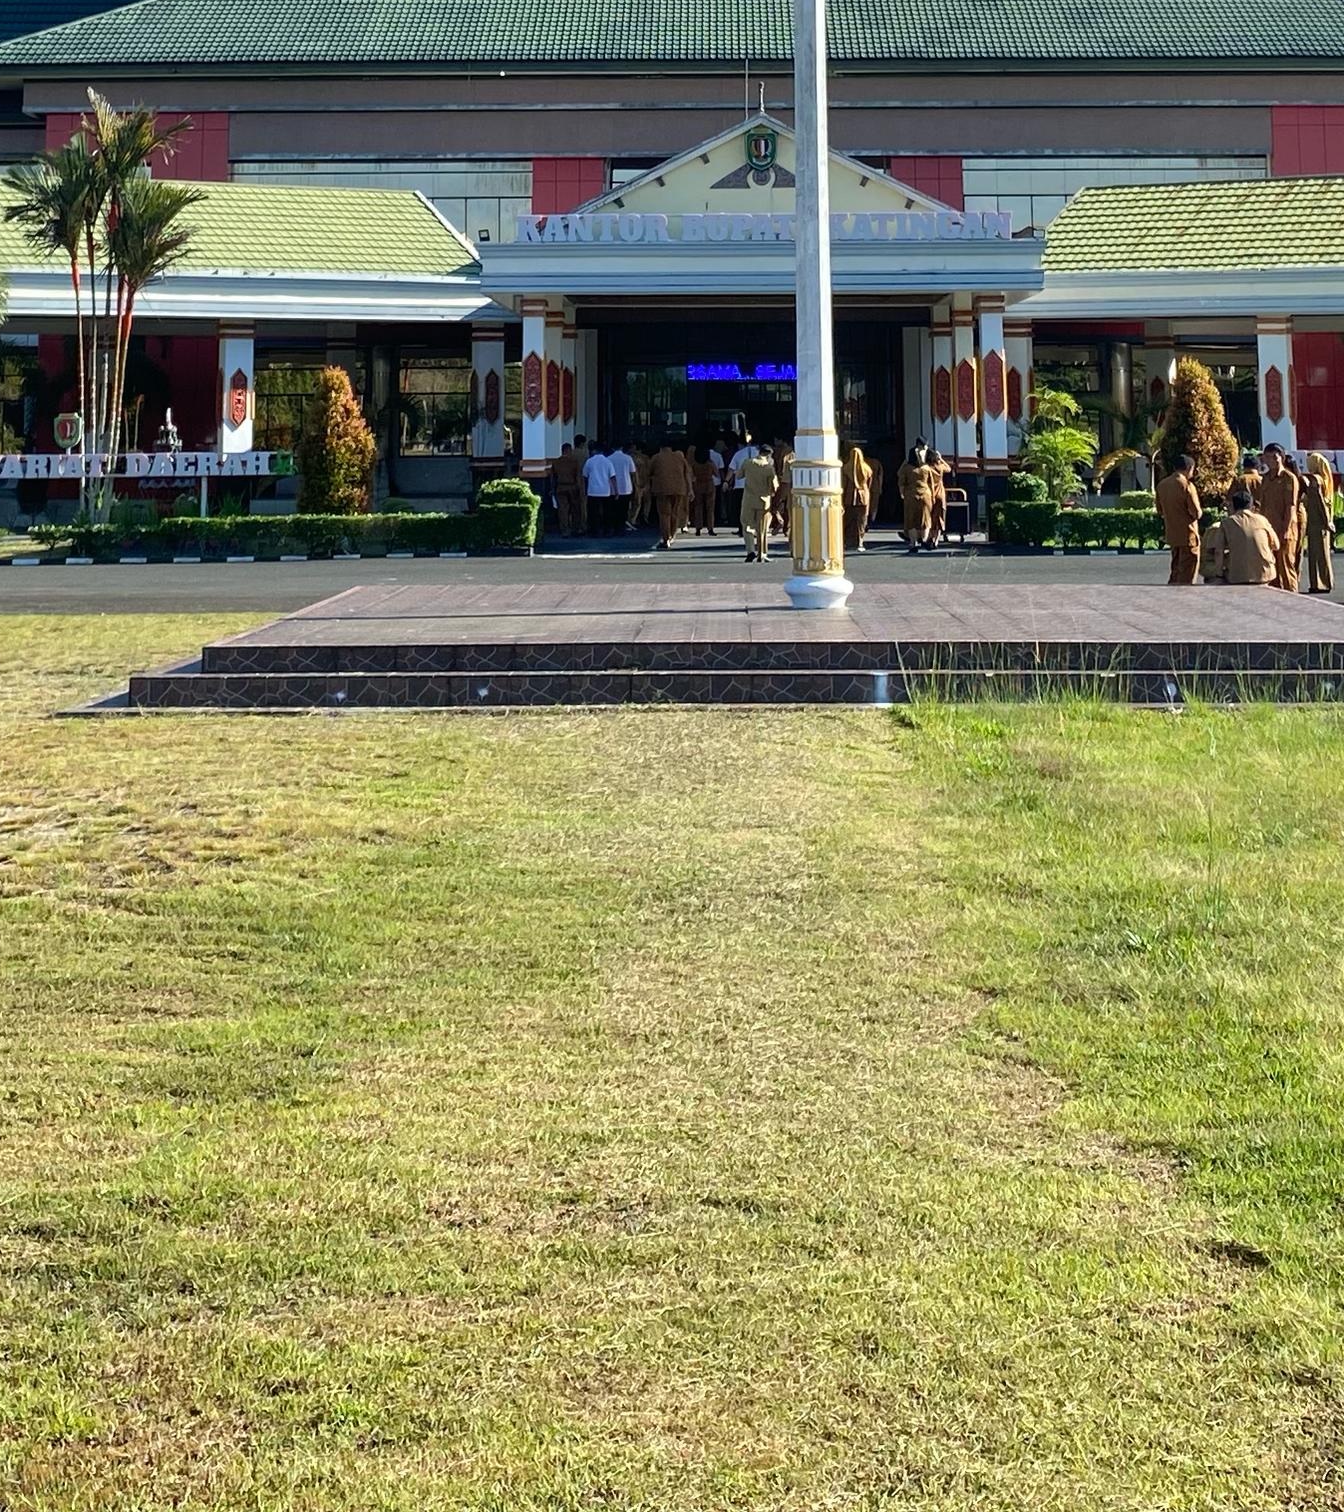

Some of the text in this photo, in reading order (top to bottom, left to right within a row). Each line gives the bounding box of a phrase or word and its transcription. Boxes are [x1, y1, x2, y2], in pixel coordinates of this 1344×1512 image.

[517, 211, 1012, 242] KANTOR BUPAT KATINGAN
[125, 451, 270, 477] DAERAH
